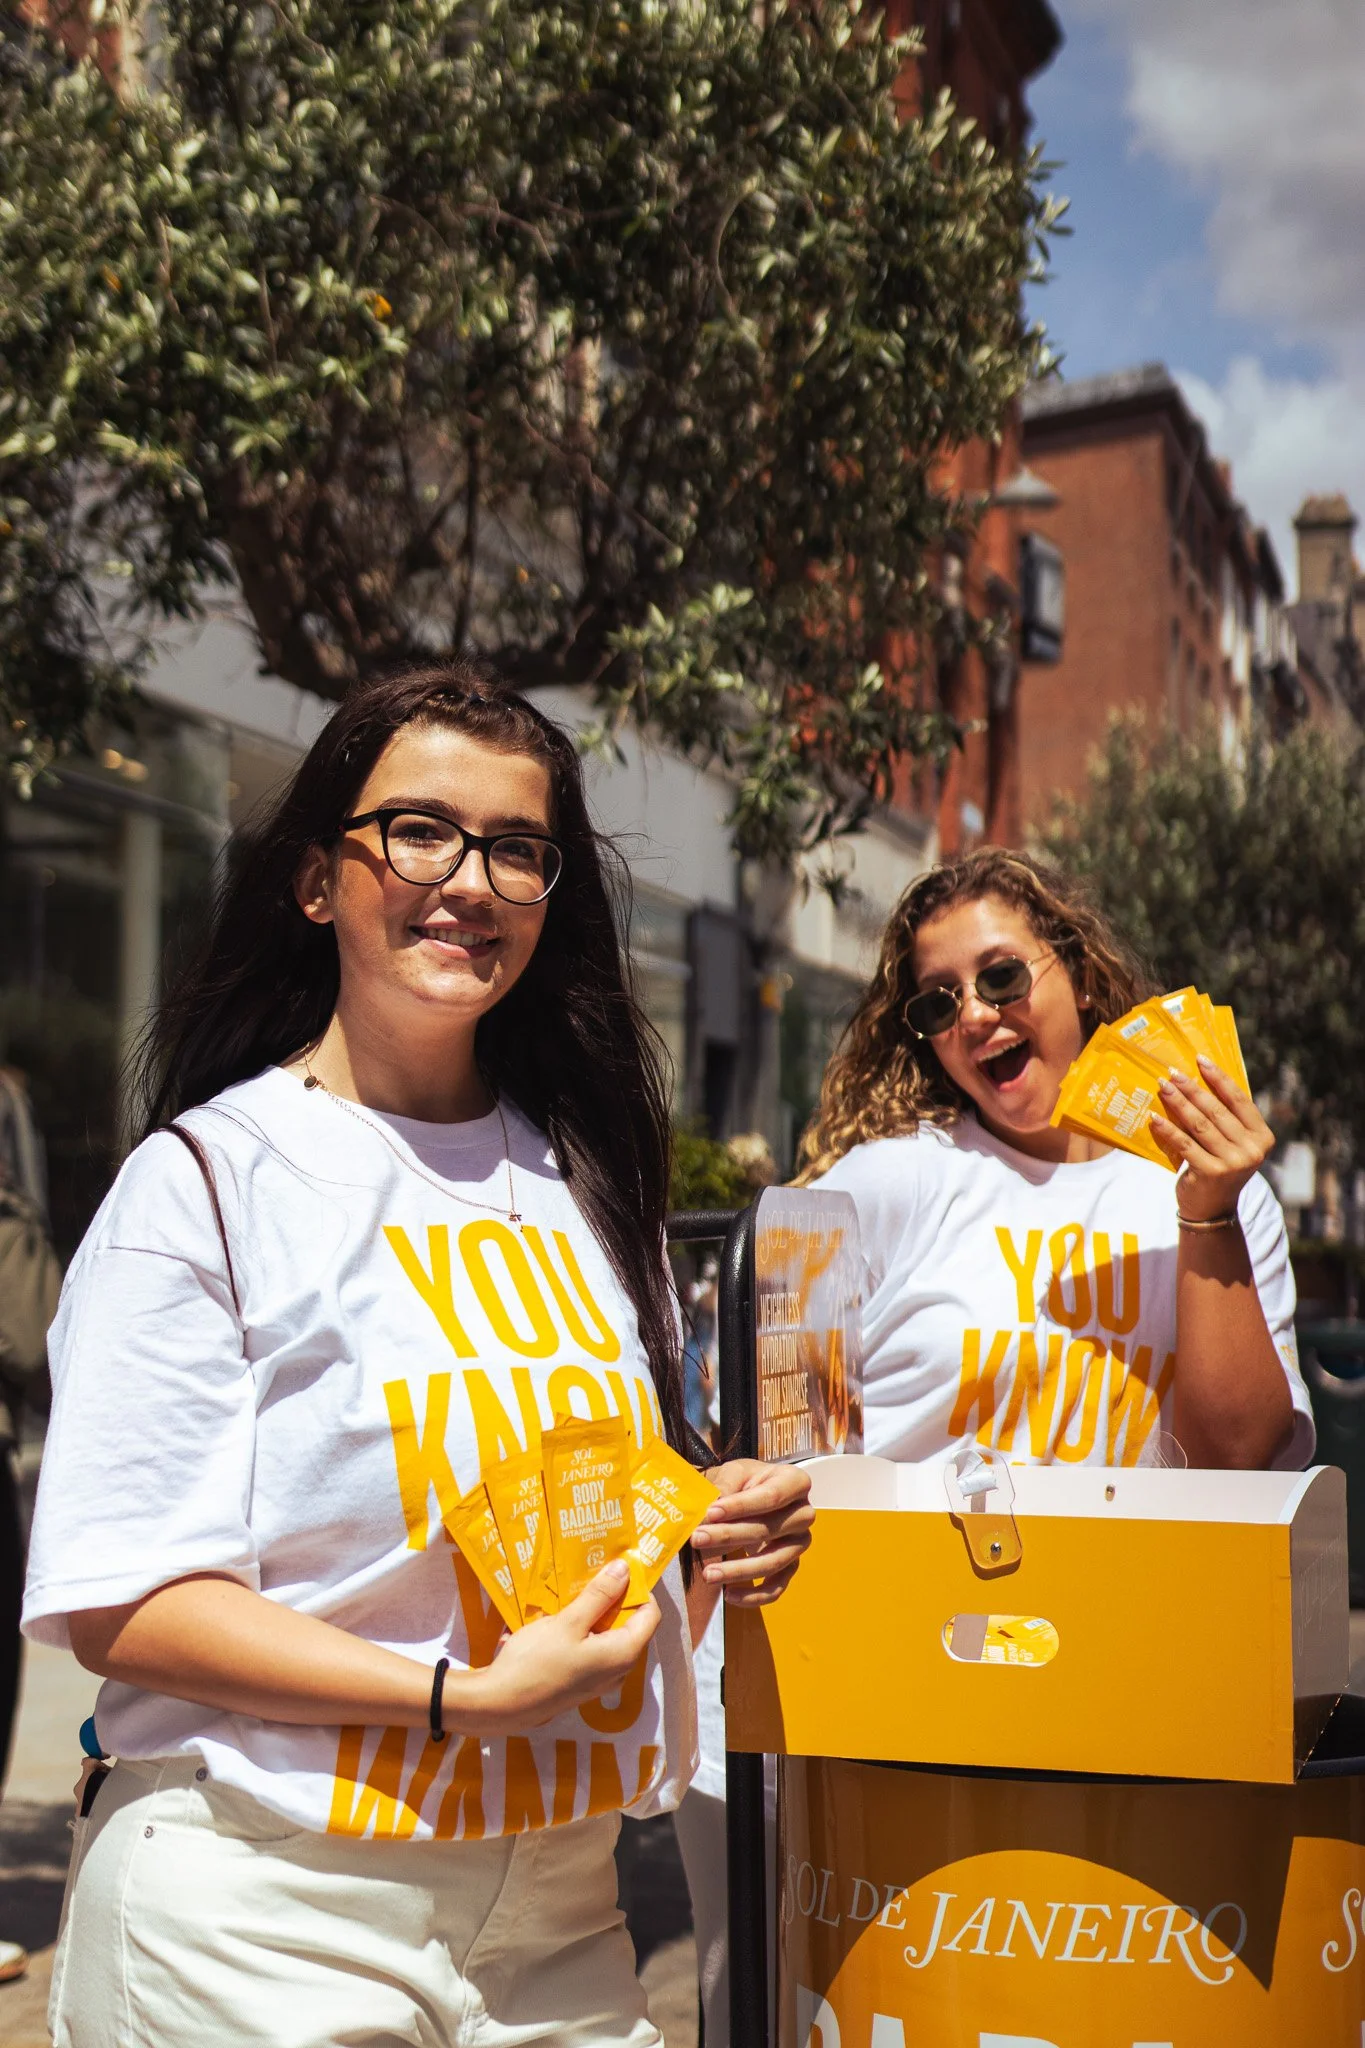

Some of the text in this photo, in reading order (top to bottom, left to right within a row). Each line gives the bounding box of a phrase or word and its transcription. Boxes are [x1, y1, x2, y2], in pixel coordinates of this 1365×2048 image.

[760, 1211, 786, 1265] SOL
[382, 1219, 621, 1363] YOU
[994, 1222, 1140, 1335] YOU
[760, 1291, 800, 1333] WEIGHTLESS
[761, 1333, 798, 1376] HYDRATION
[762, 1372, 809, 1419] FROM SUNRISE
[947, 1328, 1176, 1468] KNOW
[570, 1447, 596, 1466] SOL
[763, 1411, 813, 1462] TO AFTER PARTY
[558, 1461, 614, 1487] JANEIRO
[572, 1479, 605, 1508] BODY
[653, 1476, 680, 1498] SOL
[559, 1497, 623, 1531] BADALADA
[631, 1479, 684, 1523] JANEIRO
[633, 1496, 667, 1534] BODY
[783, 1854, 841, 1928] SOL
[847, 1877, 910, 1930] DE
[903, 1891, 1248, 1985] JANEIRO
